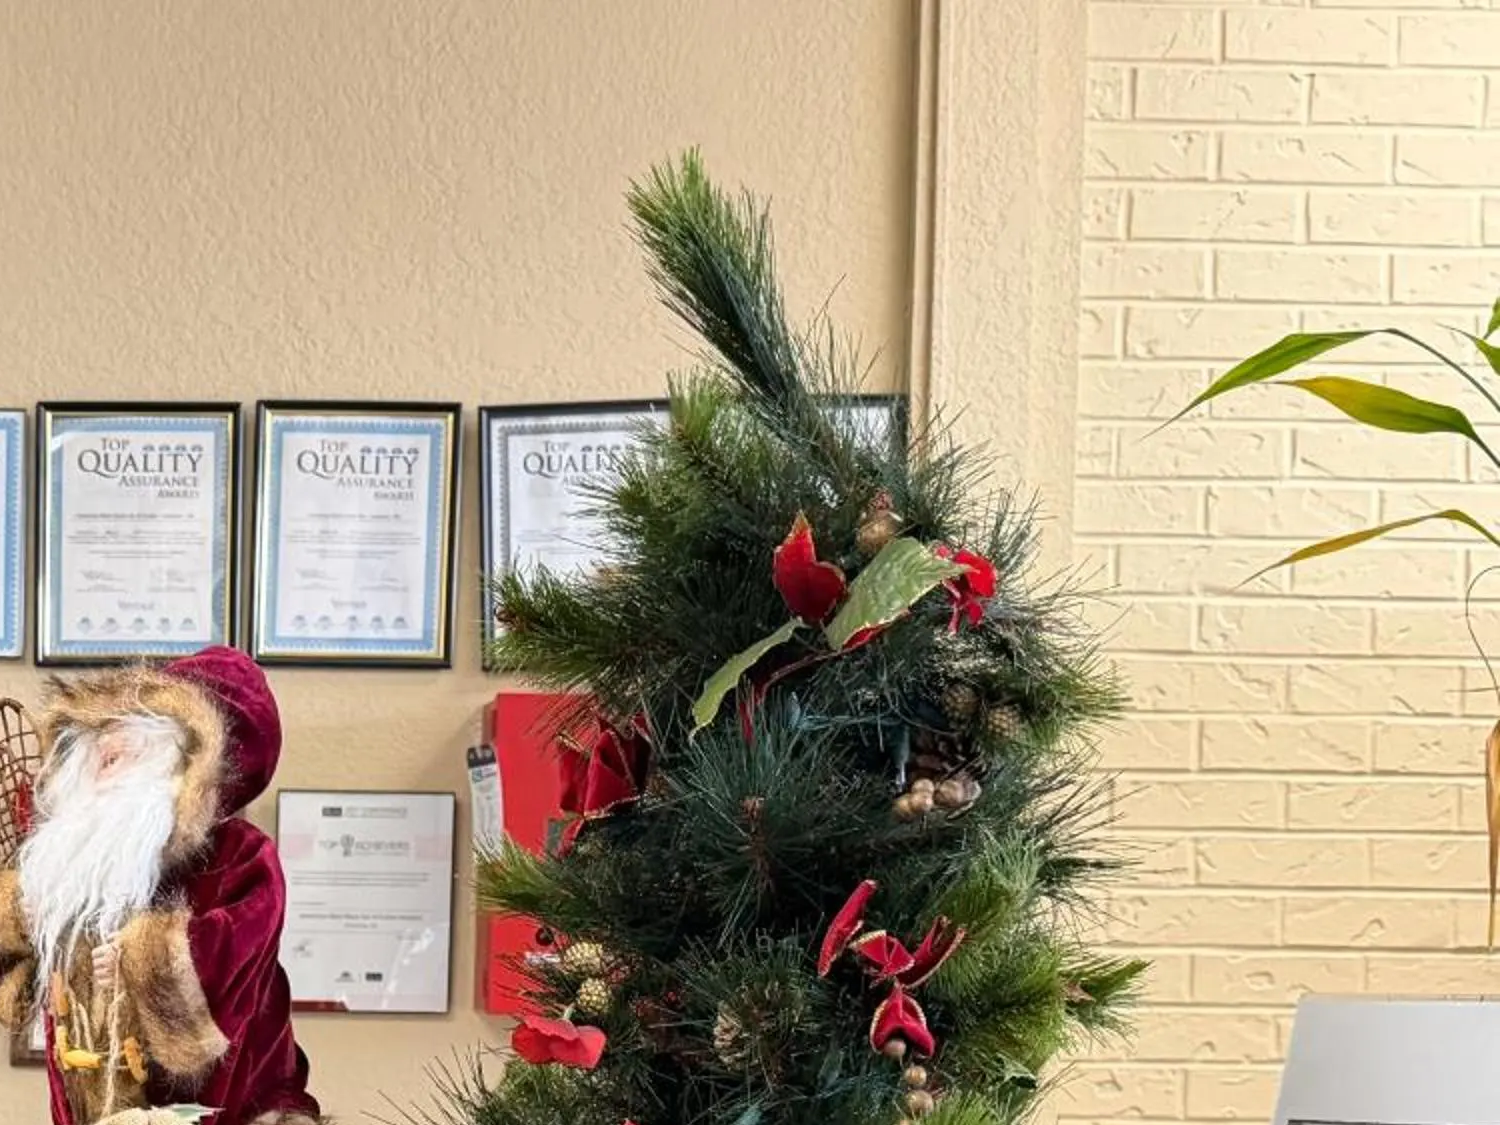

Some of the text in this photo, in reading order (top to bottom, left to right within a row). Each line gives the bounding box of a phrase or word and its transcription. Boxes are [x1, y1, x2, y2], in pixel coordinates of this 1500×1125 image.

[101, 437, 130, 451] TOP
[320, 439, 349, 453] TOP
[544, 440, 570, 453] TOP
[77, 449, 203, 479] QUALITY
[296, 449, 419, 480] QUALITY
[119, 476, 199, 488] ASSURANCE
[338, 477, 414, 490] ASSURANCE
